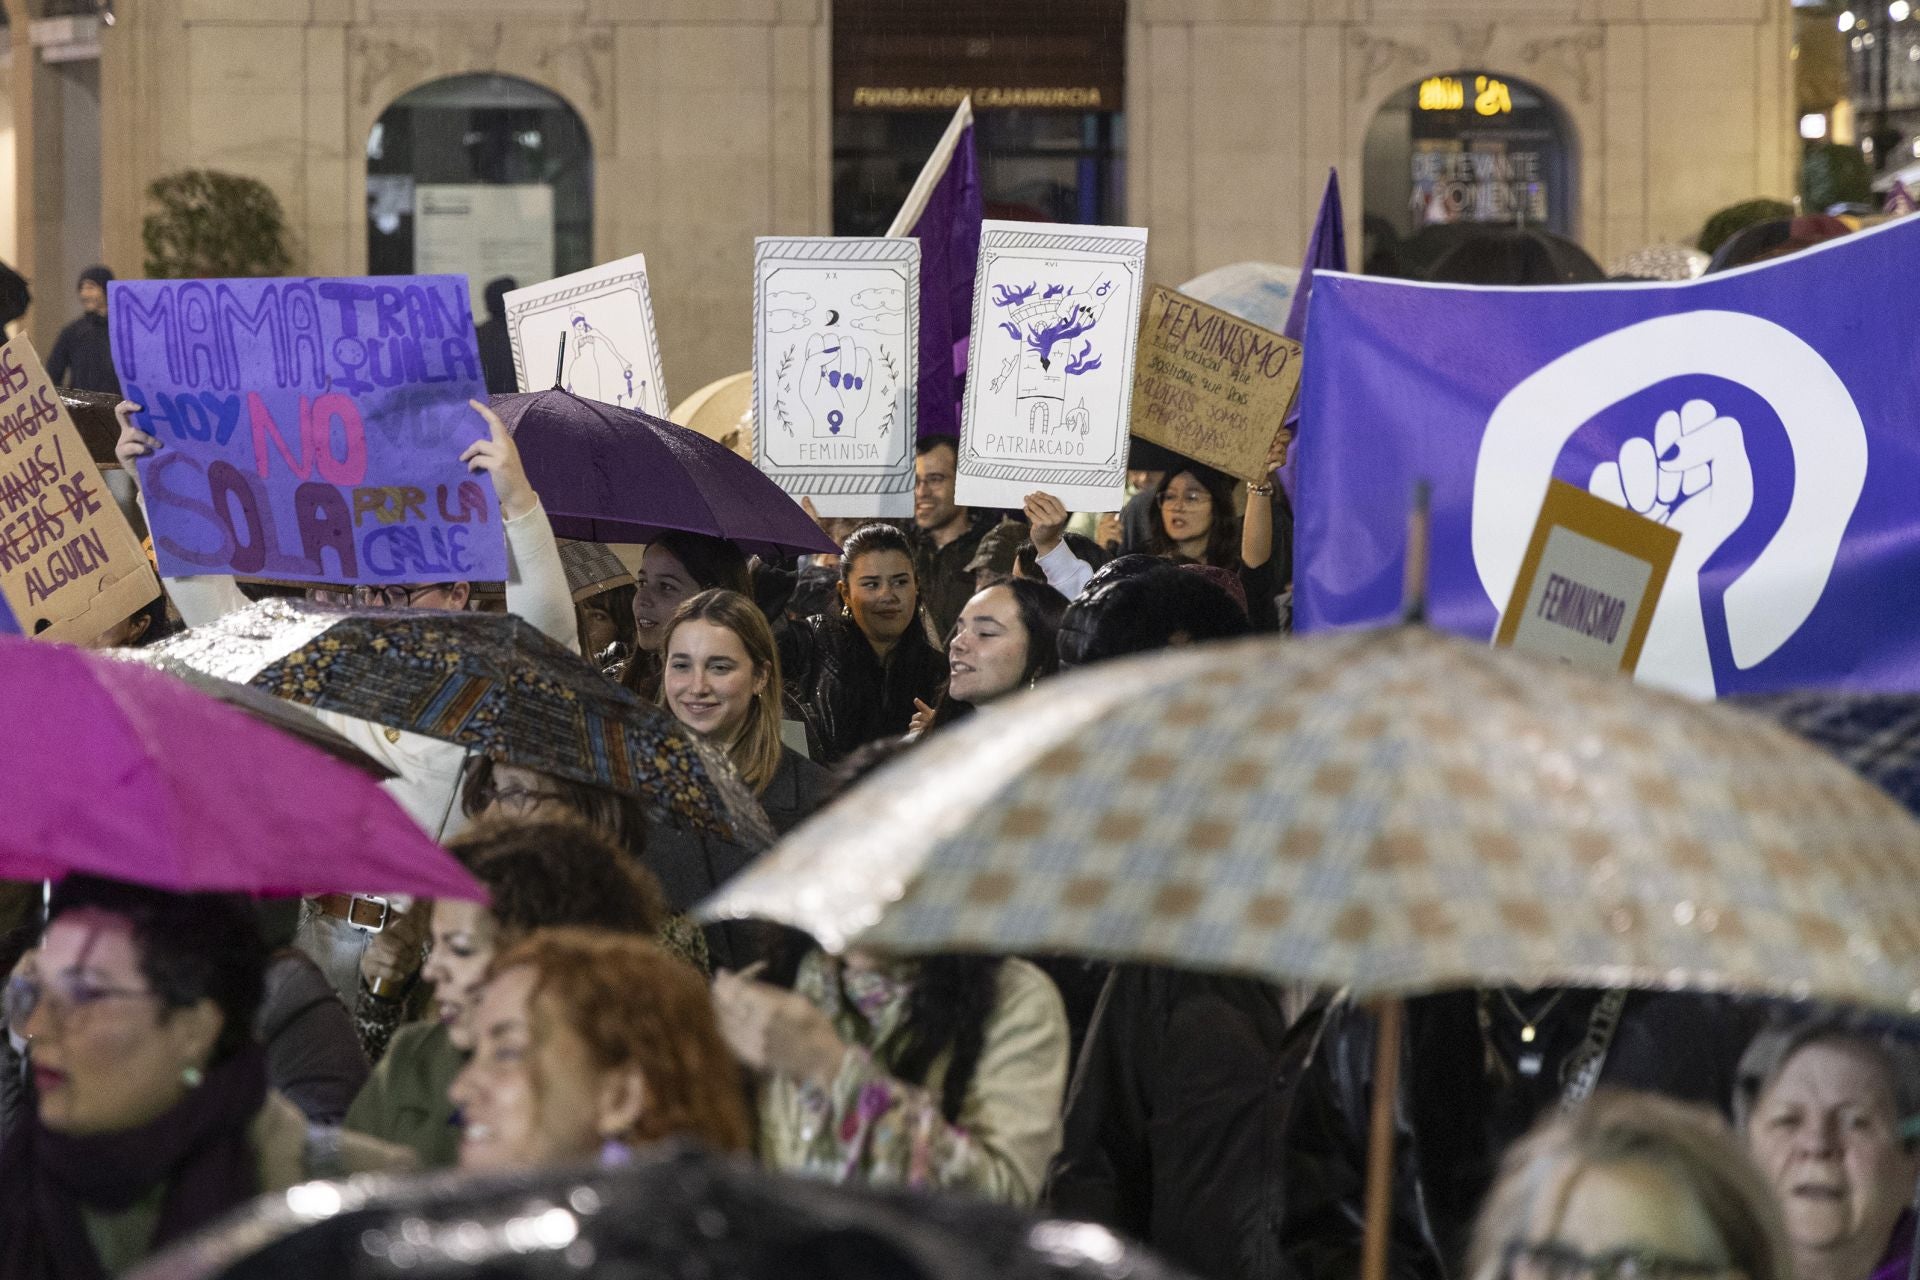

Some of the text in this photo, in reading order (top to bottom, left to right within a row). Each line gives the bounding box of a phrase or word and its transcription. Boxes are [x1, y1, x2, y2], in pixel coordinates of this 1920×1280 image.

[319, 282, 467, 339] TRAN
[1201, 377, 1222, 395] que
[127, 384, 240, 446] HOY
[247, 391, 368, 487] NO
[799, 443, 879, 461] FEMINISTA
[986, 433, 1085, 457] PATRIARCADO
[58, 470, 102, 524] DE
[146, 451, 488, 578] SOLA POR LA
[24, 527, 110, 607] ALGUIEN
[1536, 571, 1627, 645] FEMINISMO
